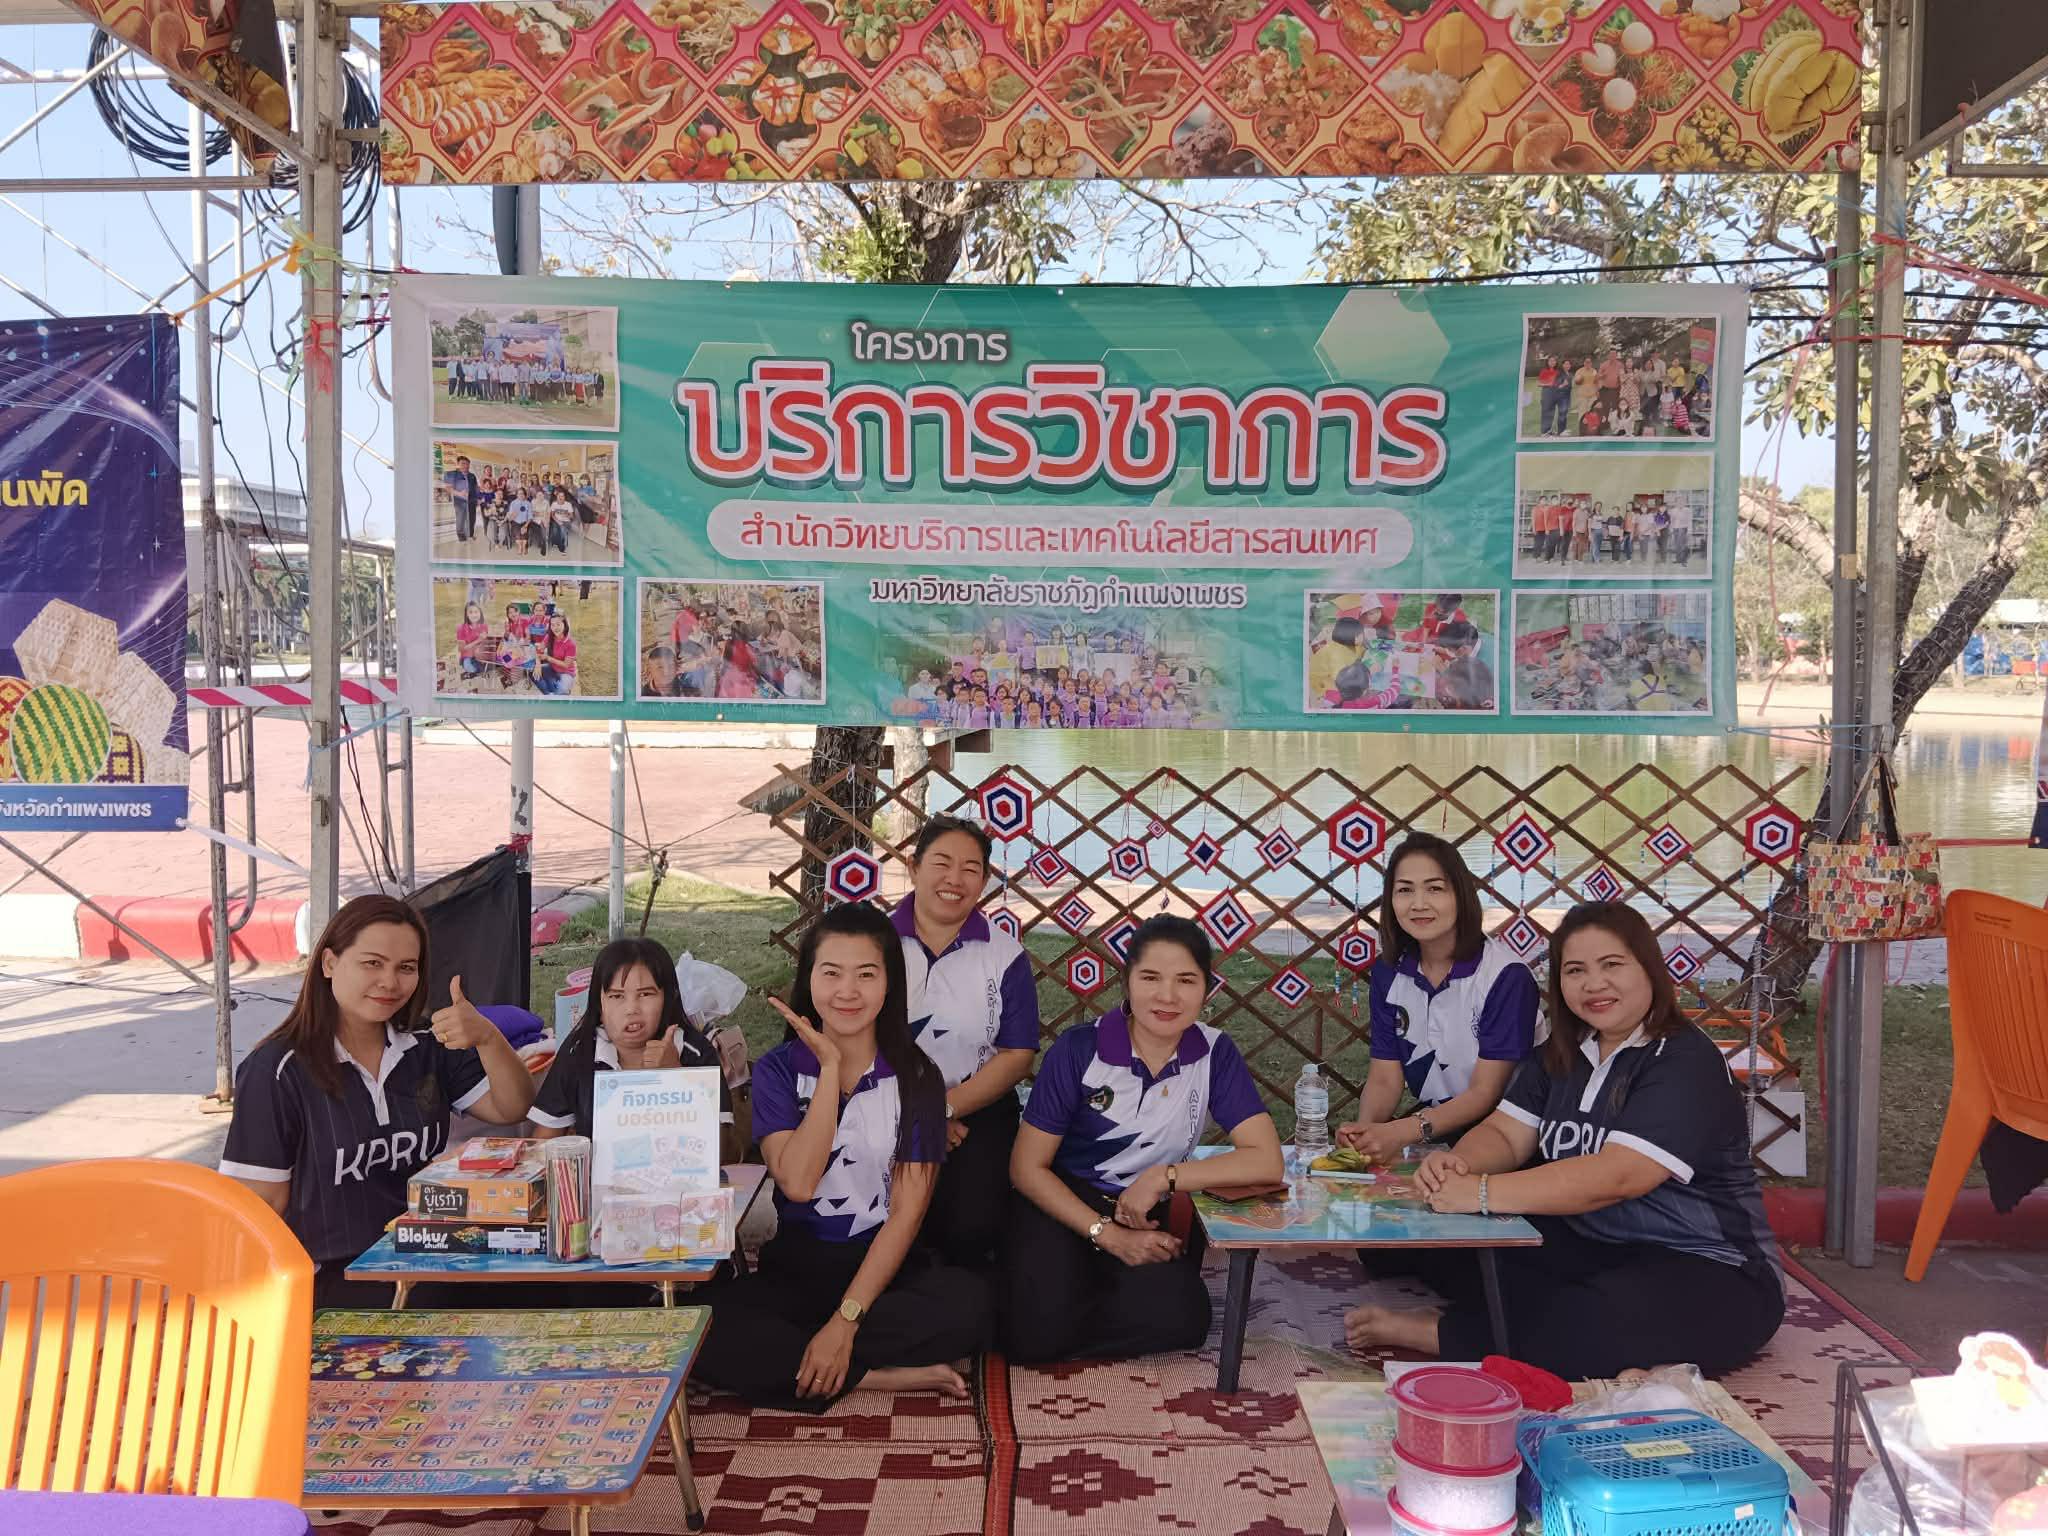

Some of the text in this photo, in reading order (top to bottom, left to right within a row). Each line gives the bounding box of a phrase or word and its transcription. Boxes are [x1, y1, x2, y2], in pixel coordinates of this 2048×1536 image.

[851, 322, 1008, 362] โครงการ
[677, 359, 1448, 489] บริการวิชาการ
[0, 469, 88, 507] นพัด
[741, 511, 1378, 555] สำนักวิทยบริการและเทคโนโลยีสารสนเทศ
[870, 577, 1247, 613] มหาวิทยาลัยราชภัฏกำแพงเพชร
[622, 1089, 693, 1107] กิจกรรม
[616, 1107, 698, 1128] บอร์ดเกม
[334, 1122, 448, 1186] KPRU
[397, 1227, 449, 1245] Blokus
